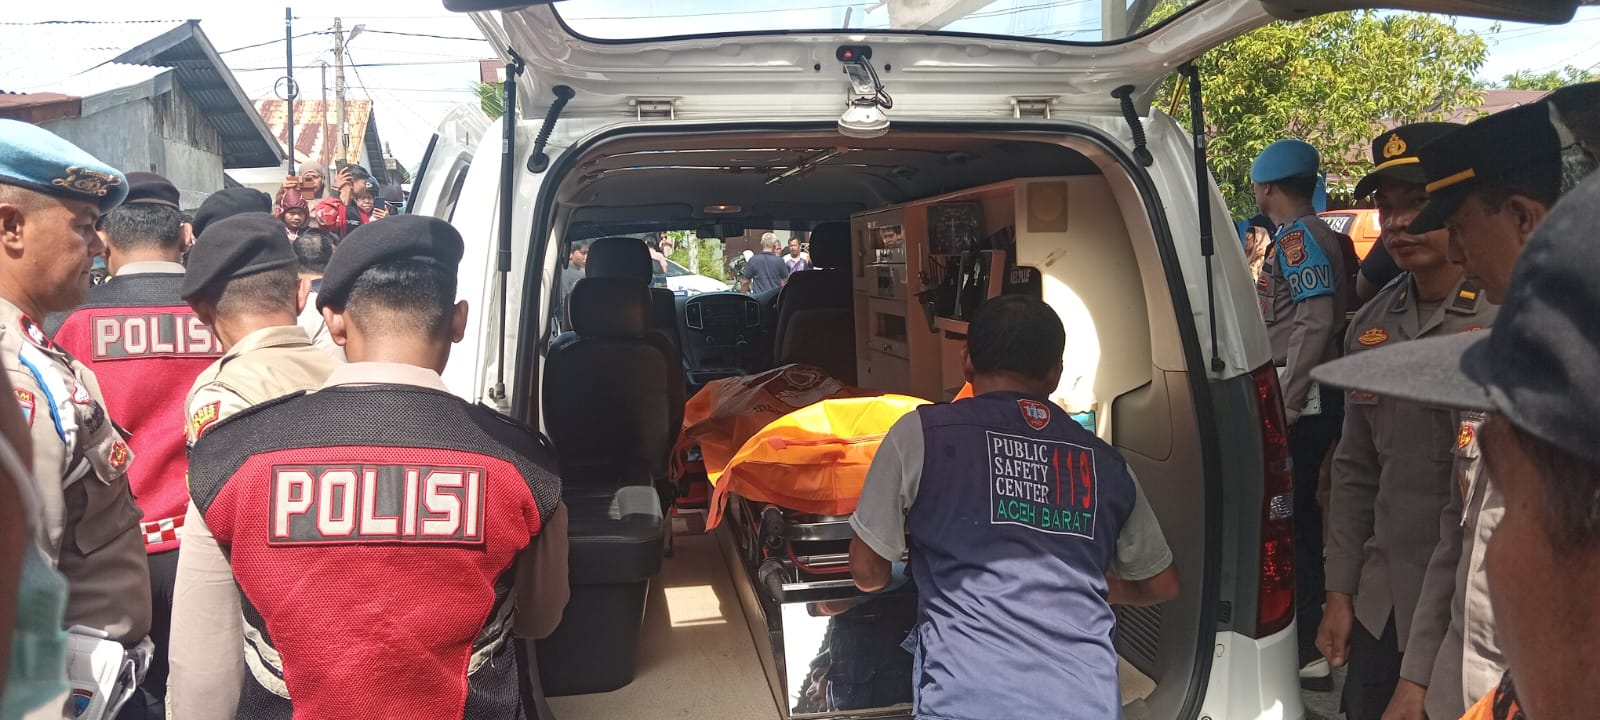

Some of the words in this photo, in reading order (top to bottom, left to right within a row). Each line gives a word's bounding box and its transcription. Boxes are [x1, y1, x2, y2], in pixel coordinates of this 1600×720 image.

[1288, 265, 1330, 297] ROV
[993, 437, 1048, 463] PUBLIC
[994, 457, 1049, 483] SAFETY
[1052, 447, 1092, 509] 119
[274, 468, 480, 538] POLISI
[995, 477, 1050, 504] CENTER
[996, 499, 1036, 525] ACEH
[1041, 507, 1092, 531] BARAT
